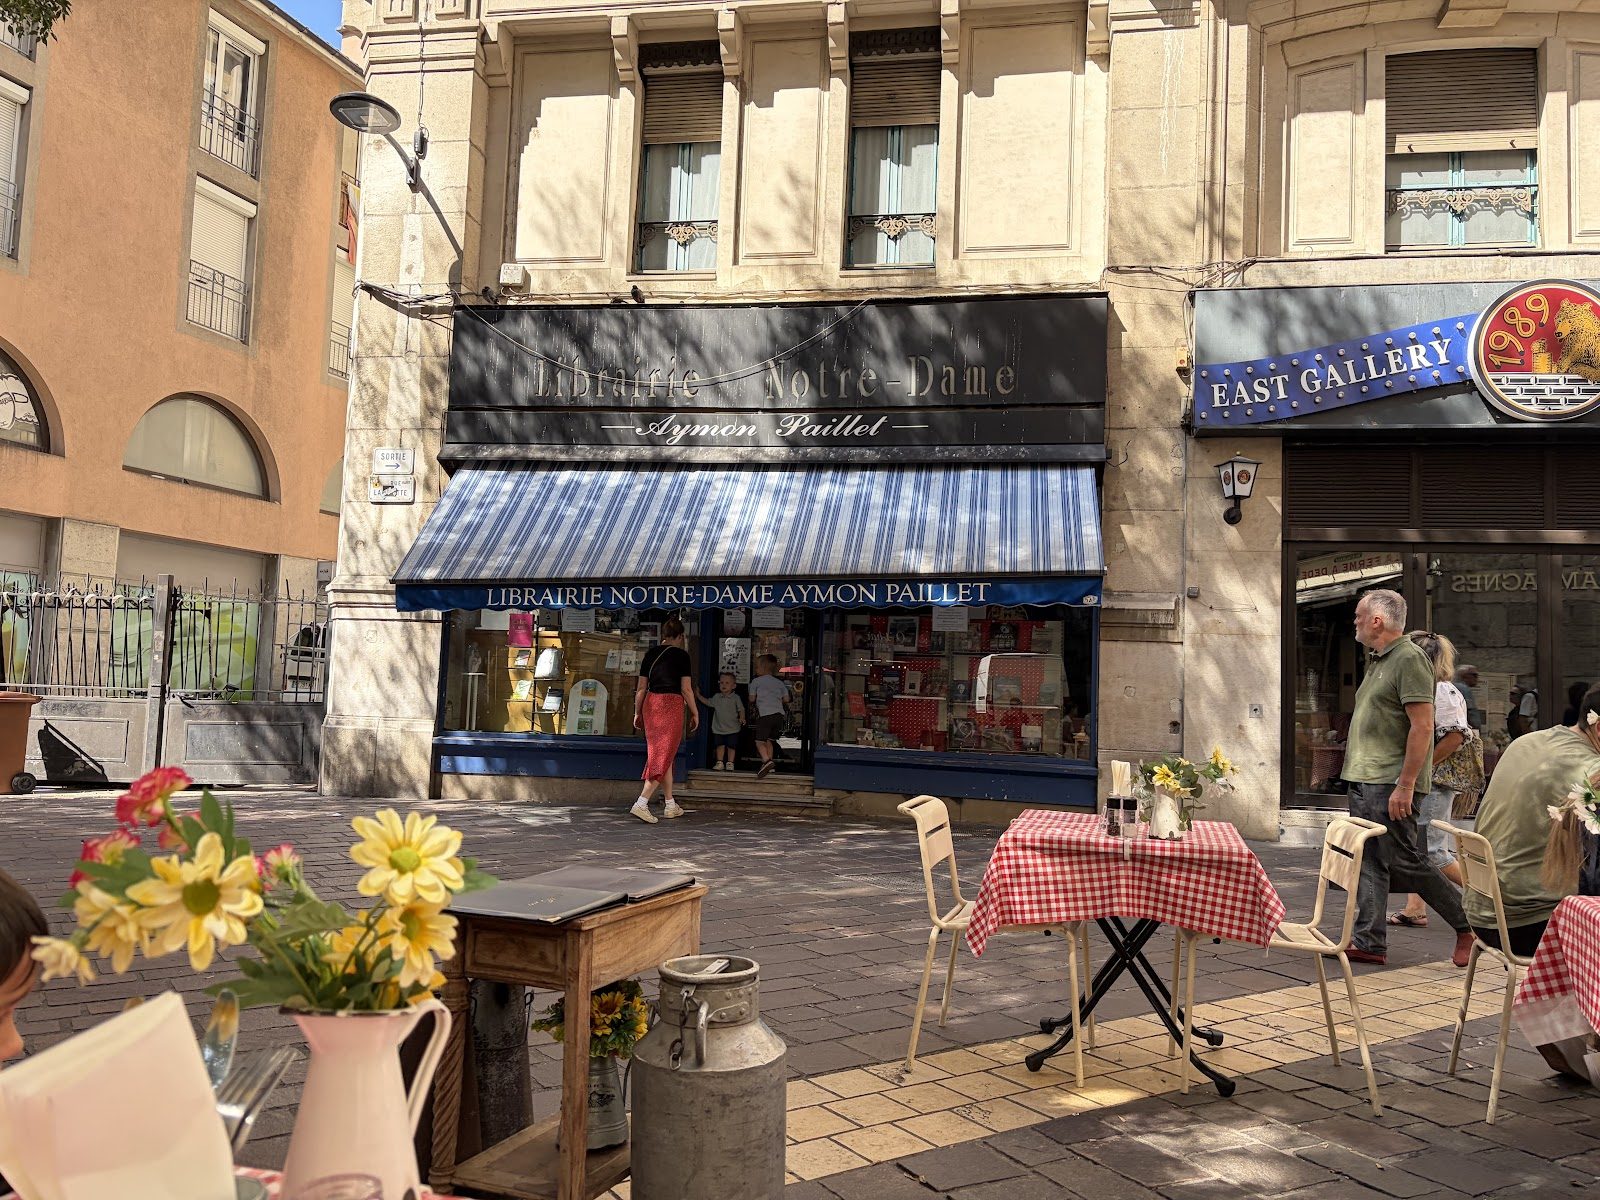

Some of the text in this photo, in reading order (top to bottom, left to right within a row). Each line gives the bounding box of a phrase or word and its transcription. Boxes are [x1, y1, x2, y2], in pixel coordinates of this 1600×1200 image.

[1488, 293, 1550, 370] 1989
[535, 355, 1016, 401] Librairie Notre-Dame
[1211, 339, 1453, 408] EAST GALLERY
[635, 414, 888, 442] Aymon Paillet
[381, 453, 406, 461] SORTIE
[487, 582, 991, 606] LIBRAIRIE NOTRE-DAME AYMON PAILLET
